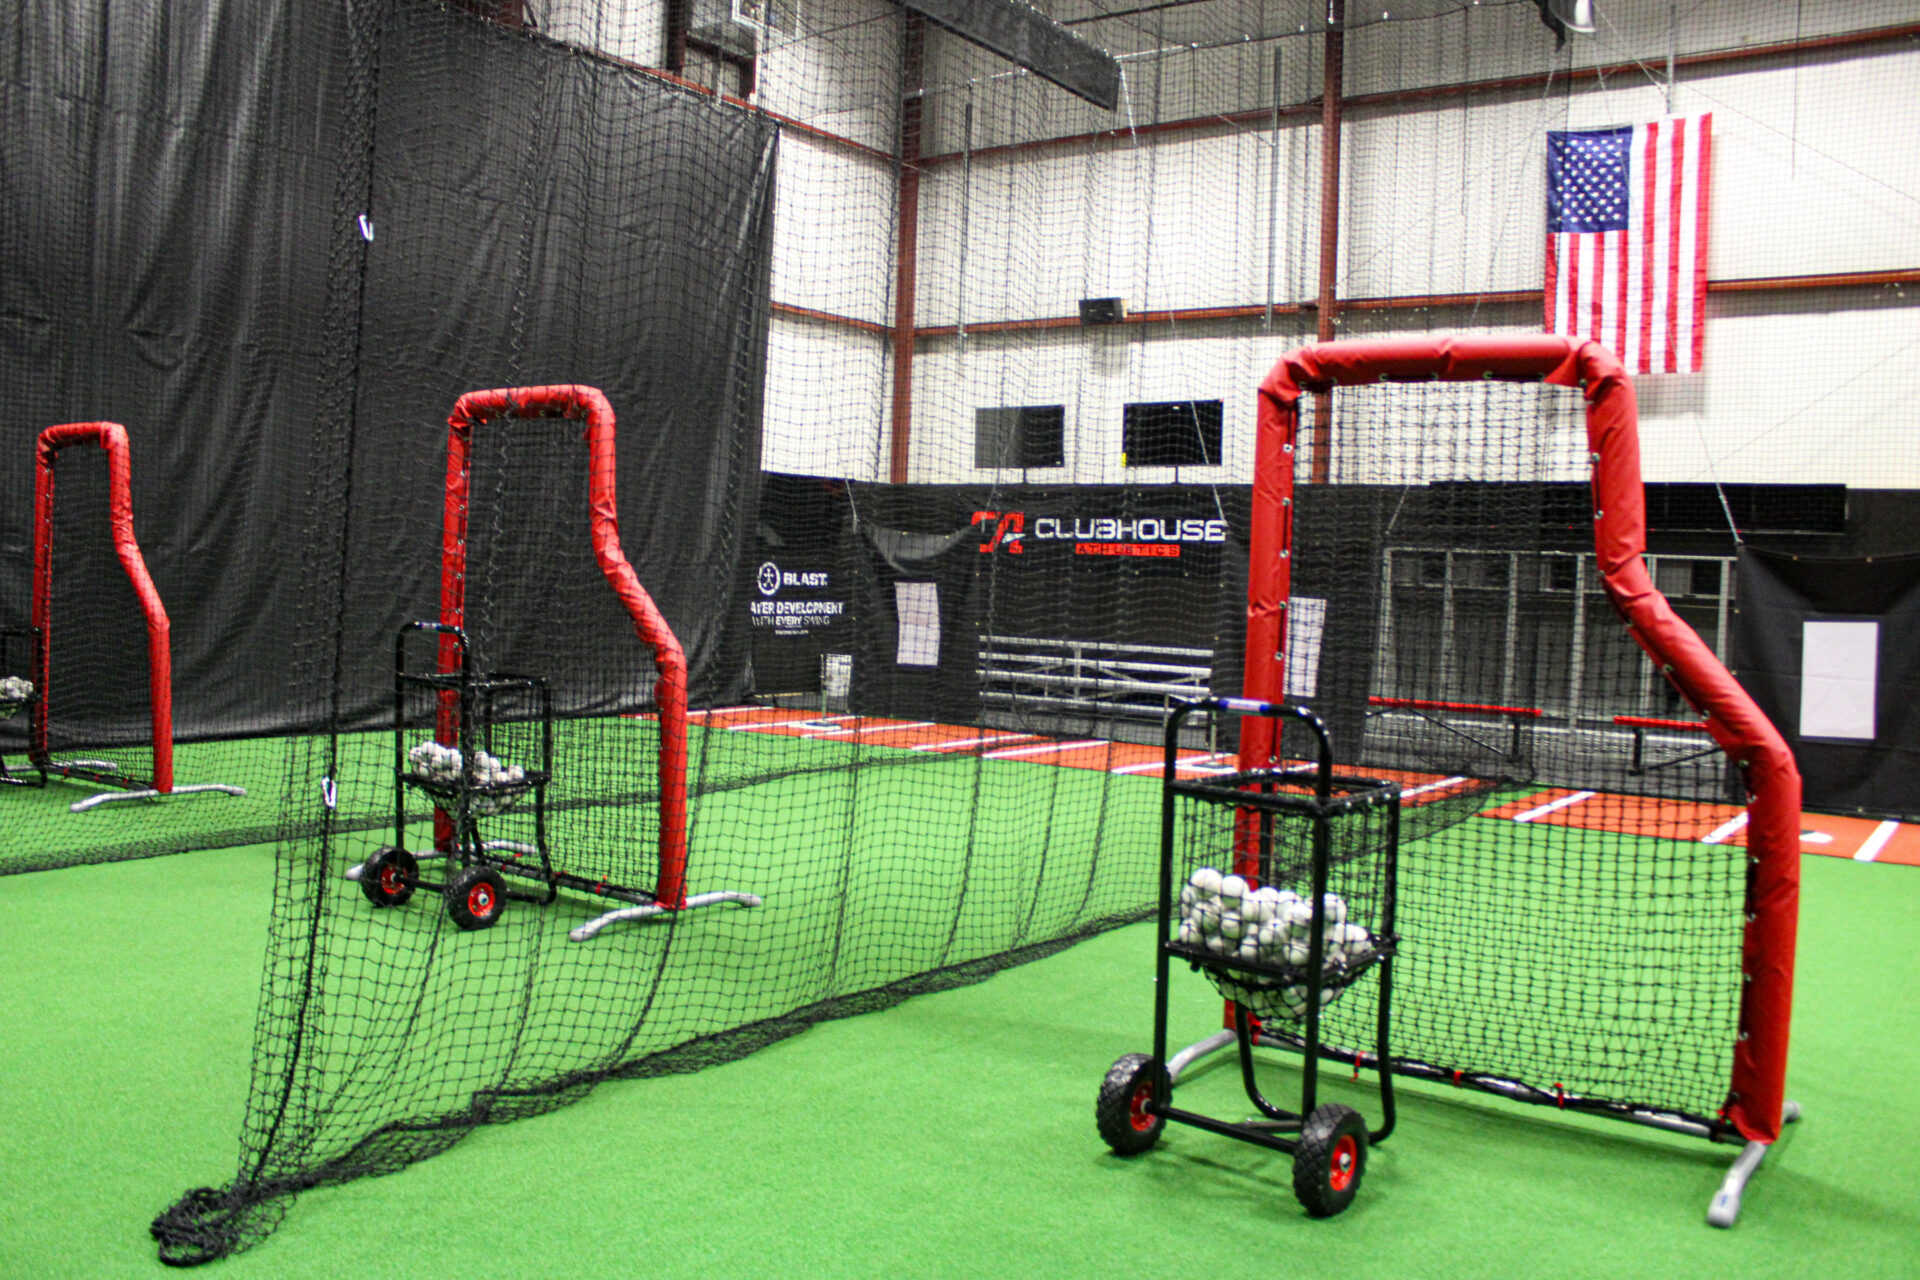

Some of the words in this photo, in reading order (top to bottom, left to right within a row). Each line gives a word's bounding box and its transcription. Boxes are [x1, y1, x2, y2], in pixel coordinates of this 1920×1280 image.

[1034, 518, 1226, 541] CLUBHOUSE
[1078, 543, 1179, 556] ATHLETICS
[776, 601, 844, 615] DEVELOPMENT
[751, 616, 774, 626] WITH
[775, 616, 803, 626] EVERY
